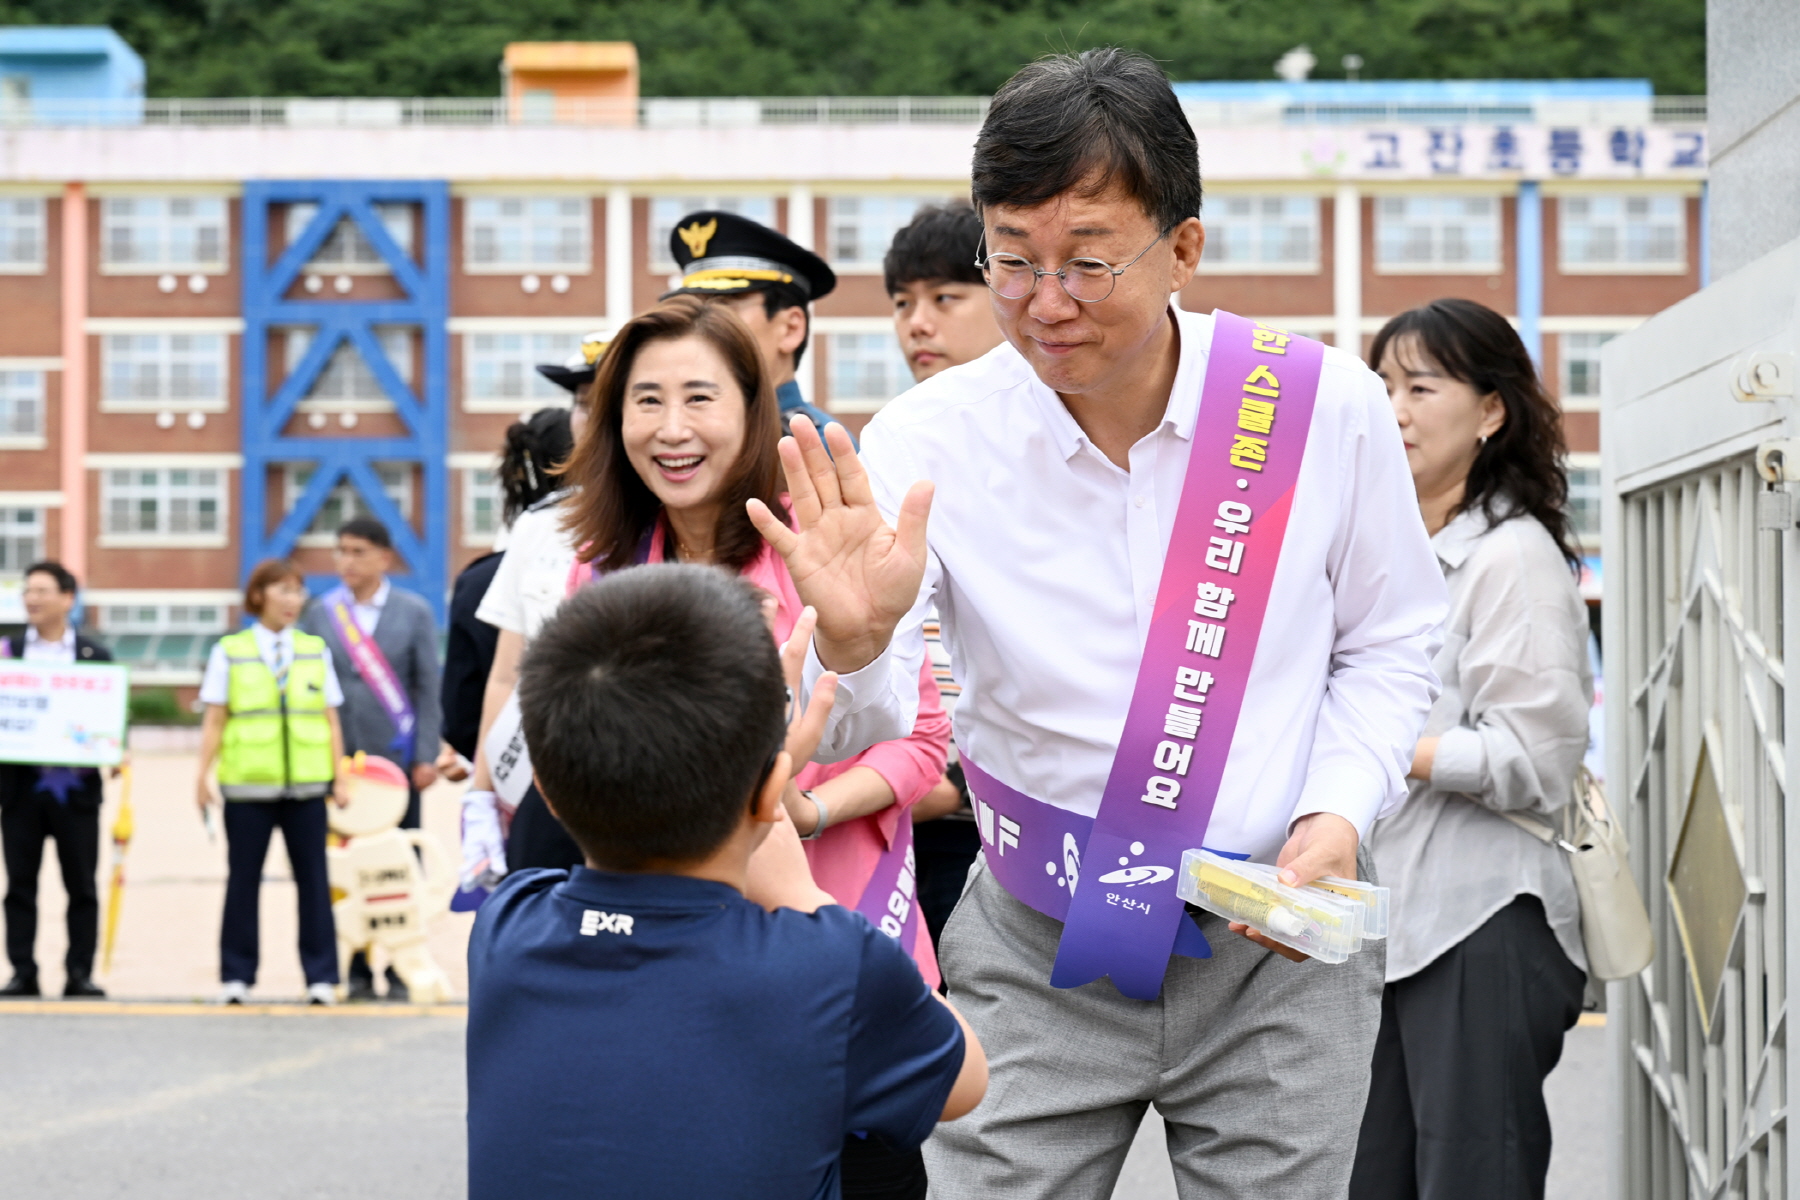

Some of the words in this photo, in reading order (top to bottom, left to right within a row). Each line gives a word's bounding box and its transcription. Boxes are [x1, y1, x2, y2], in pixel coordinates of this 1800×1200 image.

[1364, 125, 1706, 174] 고잔초등학교
[1204, 500, 1253, 574] 우리
[1185, 582, 1236, 658] 함께
[1141, 665, 1215, 809] 만들어요
[579, 909, 634, 936] EXR
[1106, 893, 1151, 915] 안산시
